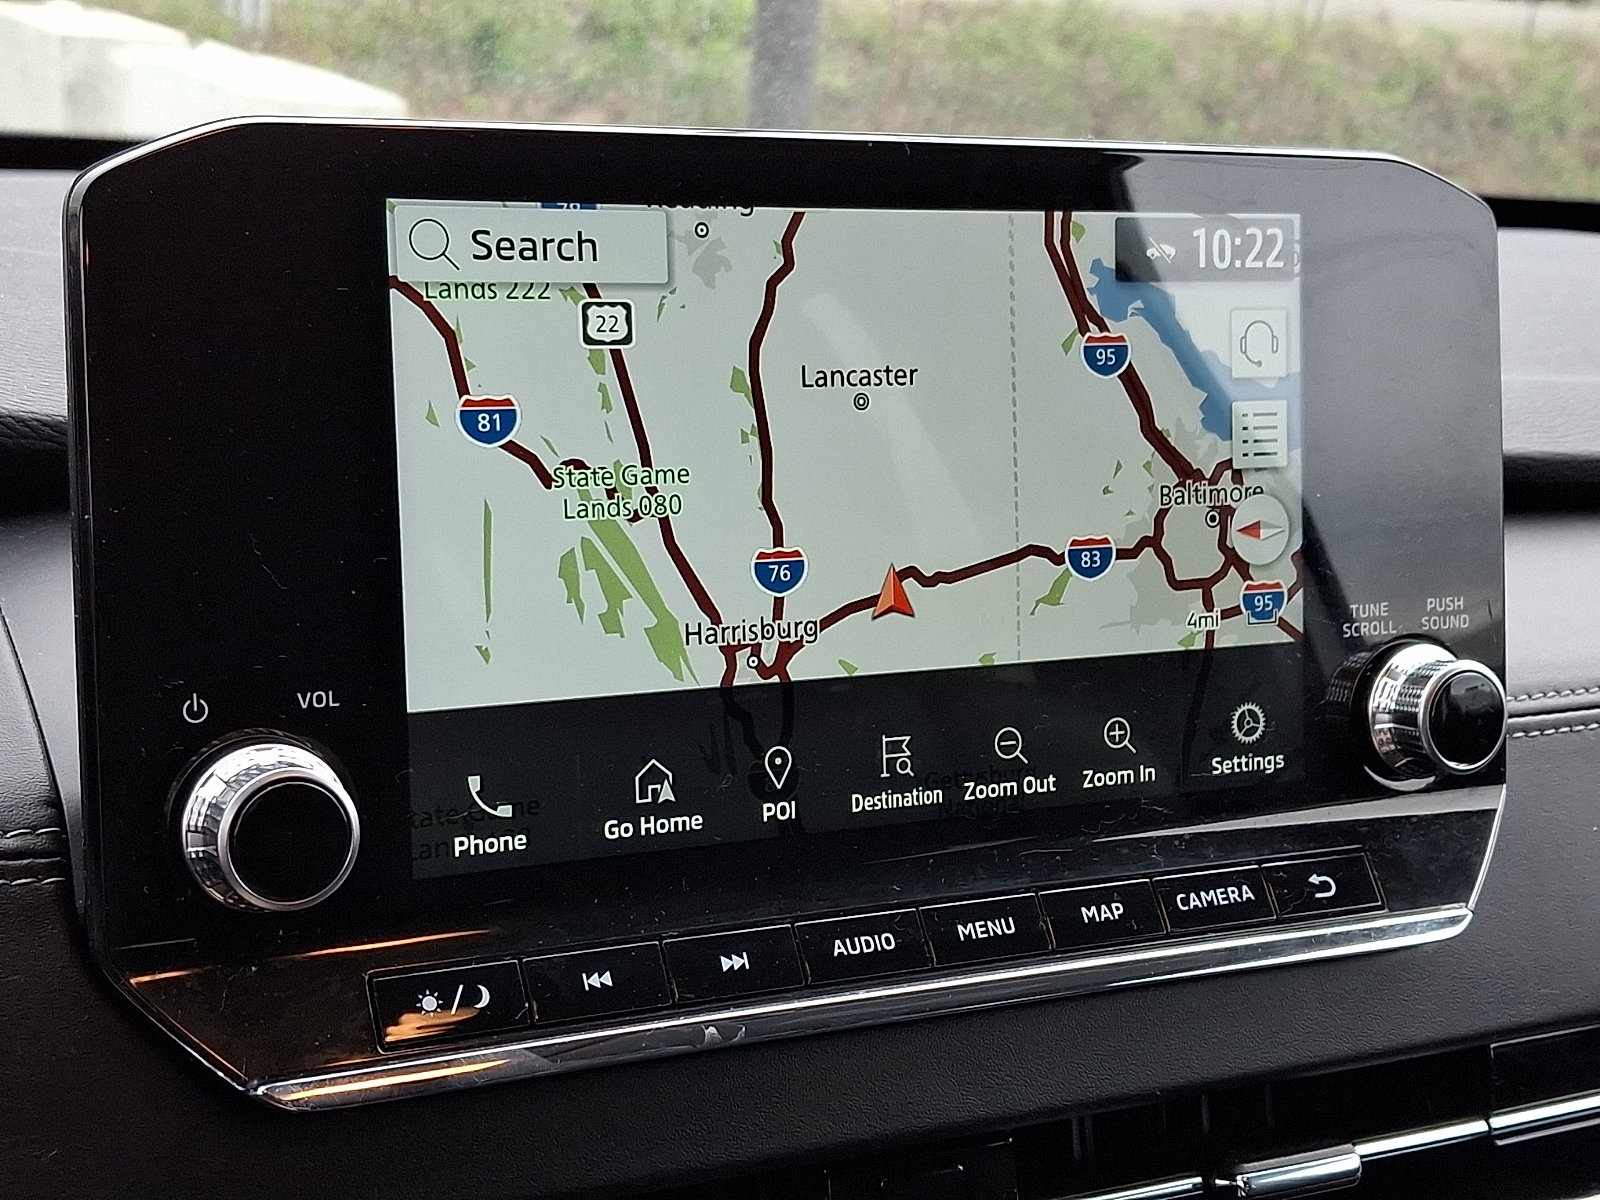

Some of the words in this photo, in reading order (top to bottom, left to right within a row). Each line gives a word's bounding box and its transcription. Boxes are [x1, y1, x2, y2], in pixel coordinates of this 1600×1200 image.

[471, 229, 598, 262] Search
[1193, 227, 1284, 269] 10:22
[424, 282, 497, 300] Lands
[505, 282, 551, 300] 222
[595, 315, 620, 333] 22
[1096, 349, 1116, 366] 95
[801, 365, 918, 388] Lancaster
[477, 413, 500, 431] 81
[553, 466, 614, 488] State
[621, 464, 690, 486] Game
[1160, 481, 1264, 506] Baltimore
[563, 497, 632, 519] Lands
[639, 493, 682, 517] 080
[1080, 551, 1101, 568] 83
[768, 564, 791, 582] 76
[1254, 595, 1273, 612] 95
[1350, 602, 1389, 618] TUNE
[1427, 597, 1464, 612] PUSH
[1186, 608, 1220, 629] 4mi
[1342, 619, 1397, 638] SCROLL
[1421, 614, 1469, 631] SOUND
[685, 616, 818, 646] Harrisburg
[297, 690, 340, 709] VOL
[1211, 752, 1285, 775] Settings
[963, 781, 1018, 801] Zoom
[1023, 774, 1056, 795] Out
[1082, 769, 1134, 789] Zoom
[1140, 765, 1156, 783] In
[851, 787, 943, 812] Destination
[763, 801, 796, 822] POI
[604, 820, 633, 839] Go
[640, 815, 703, 836] Home
[454, 834, 527, 857] Phone
[1176, 884, 1255, 911] CAMERA
[1080, 902, 1124, 923] MAP
[957, 916, 1016, 941] MENU
[833, 932, 896, 957] AUDIO
